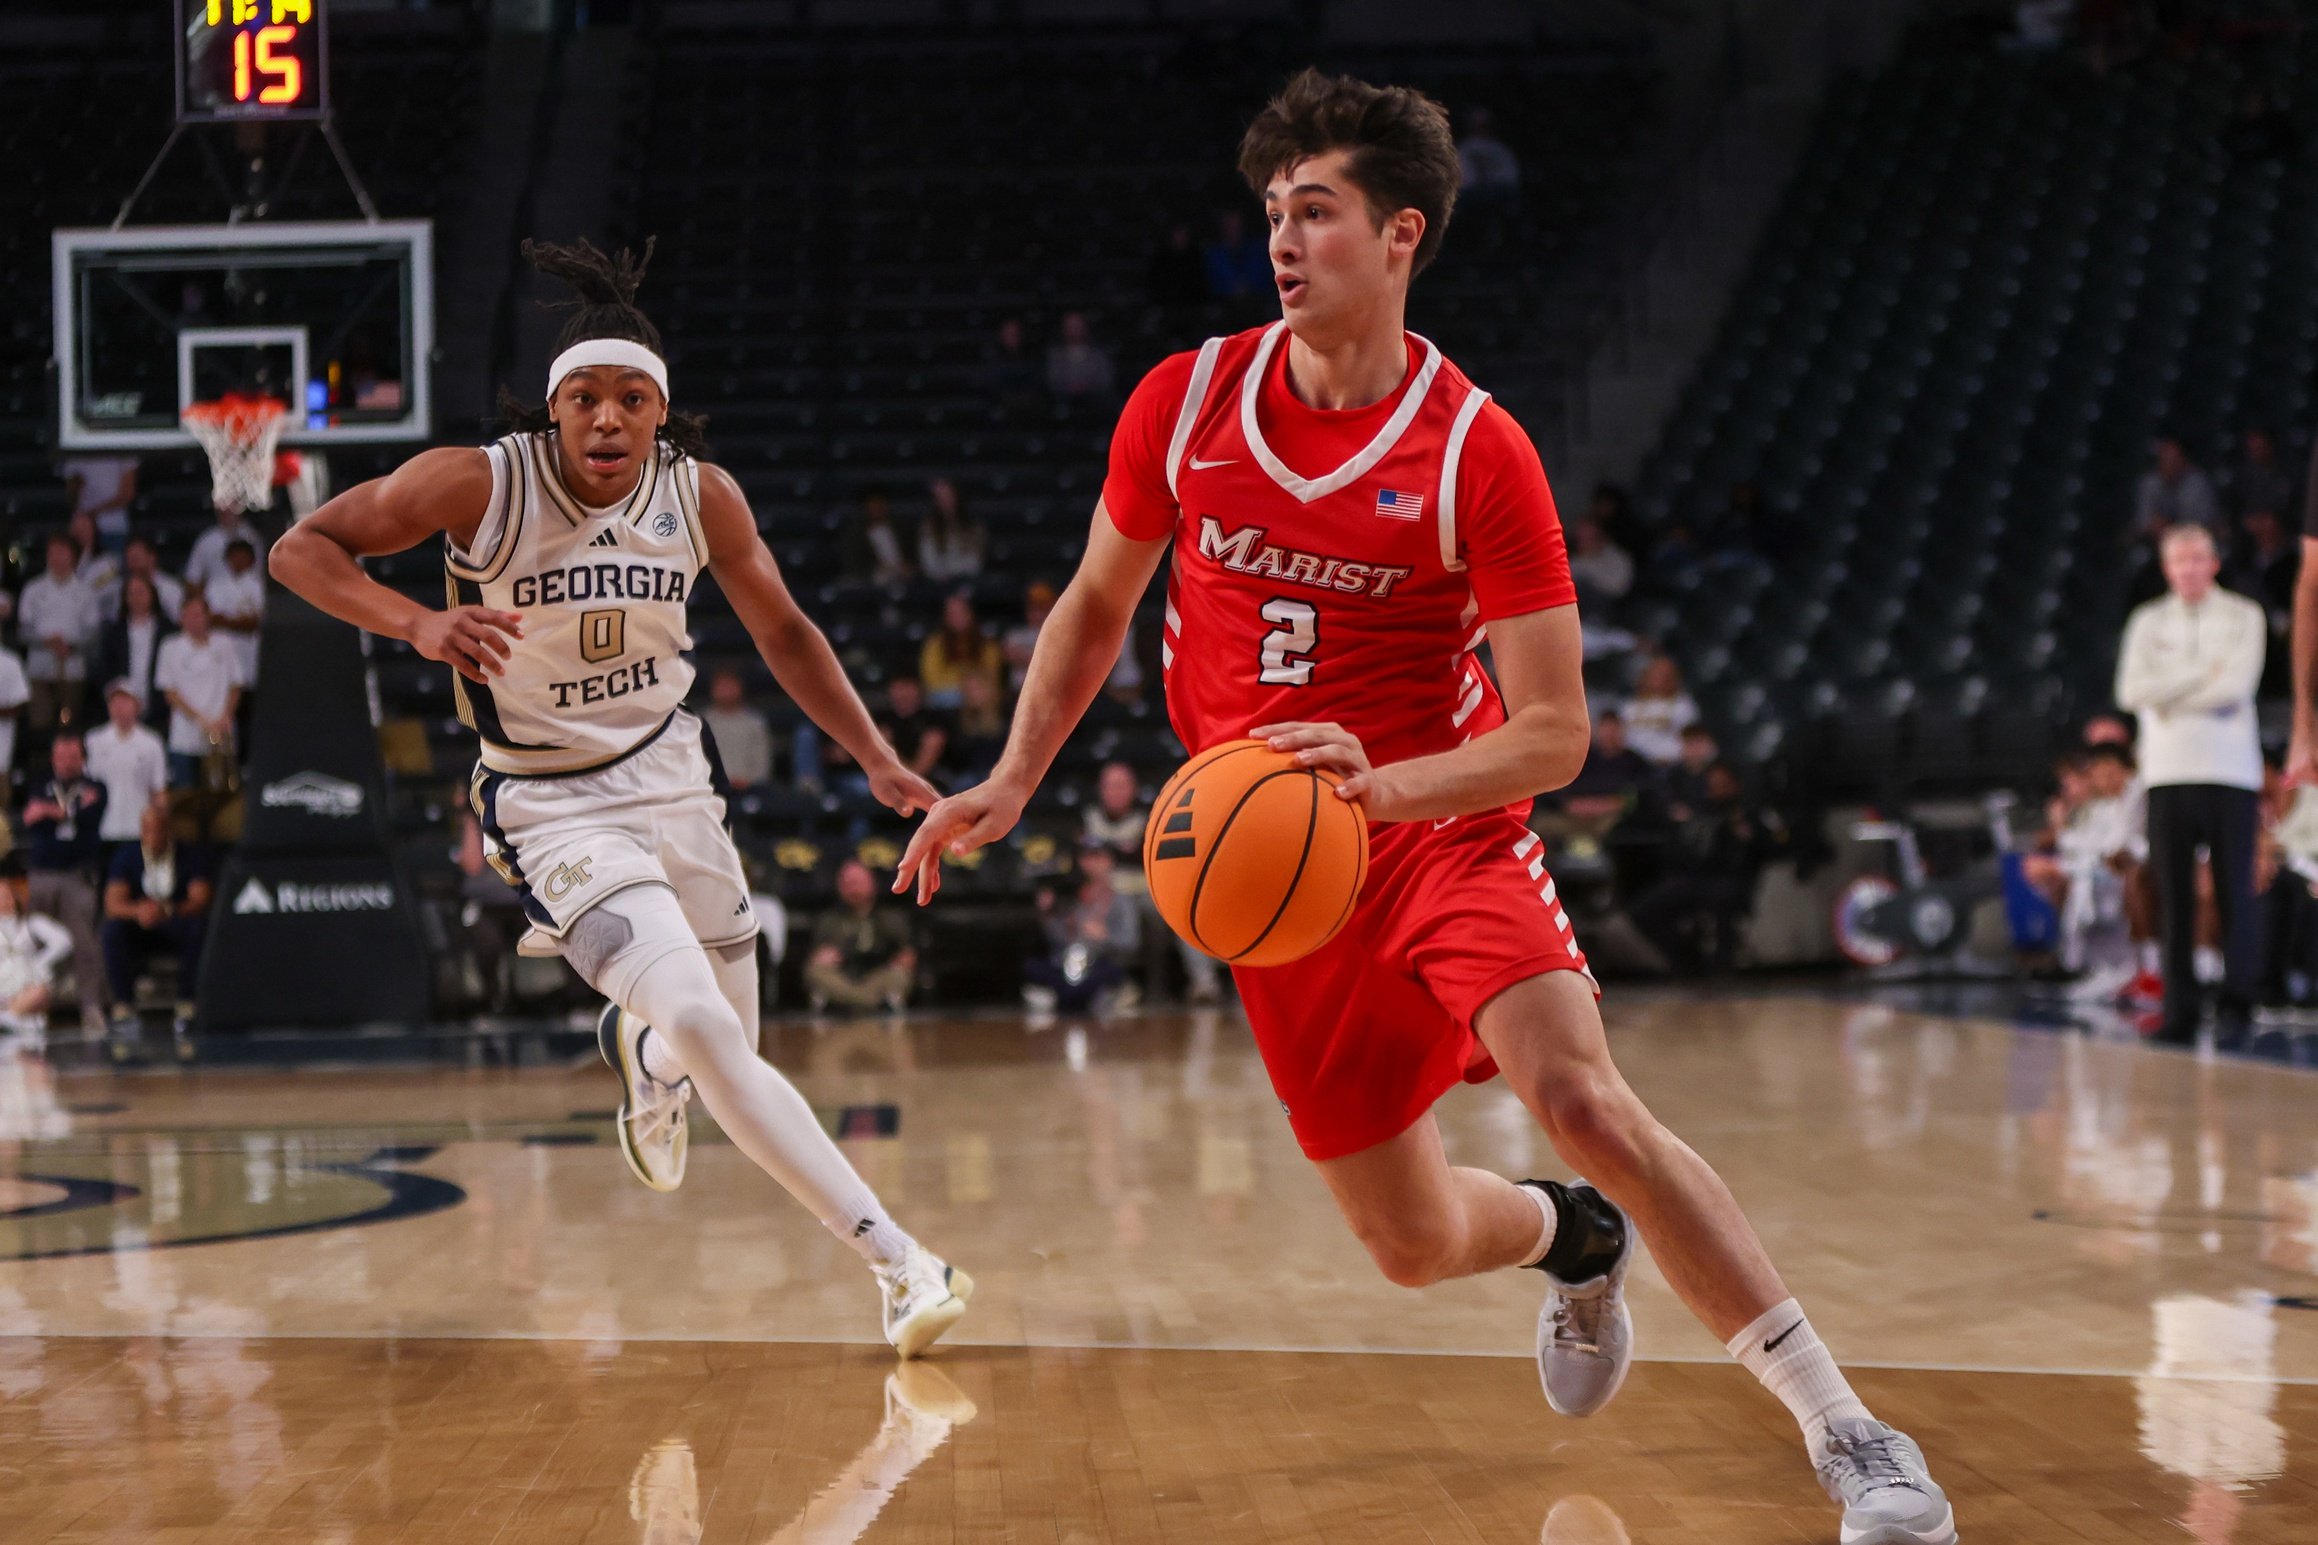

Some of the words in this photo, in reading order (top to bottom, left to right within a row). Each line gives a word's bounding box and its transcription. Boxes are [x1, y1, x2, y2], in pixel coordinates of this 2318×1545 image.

[233, 25, 302, 104] 15
[513, 564, 685, 608] GEORGIA
[580, 609, 626, 664] 0
[1258, 596, 1318, 685] 2
[549, 656, 659, 708] TECH
